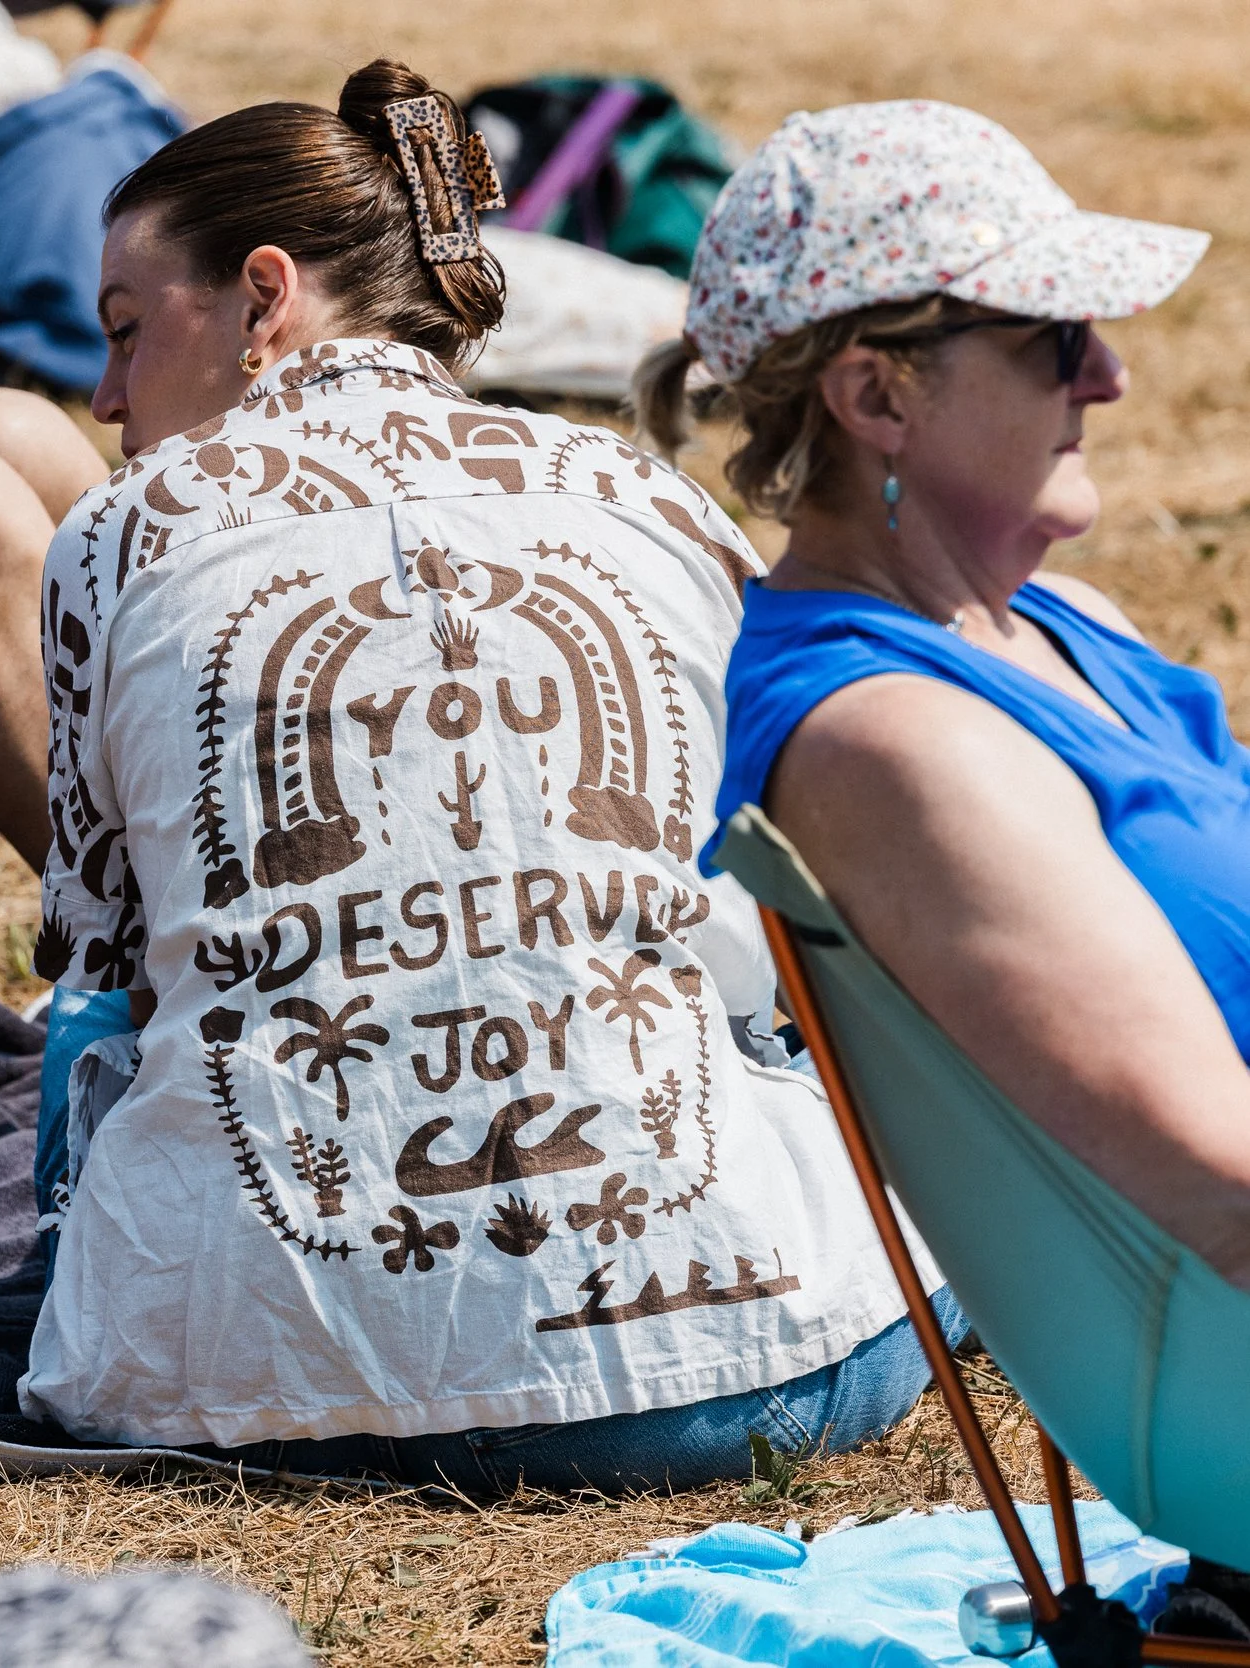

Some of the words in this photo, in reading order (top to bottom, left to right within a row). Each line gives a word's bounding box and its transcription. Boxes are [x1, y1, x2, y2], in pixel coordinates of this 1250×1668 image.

[346, 676, 561, 757] YOU
[255, 868, 669, 994] DESERVE
[411, 994, 575, 1093] JOY
